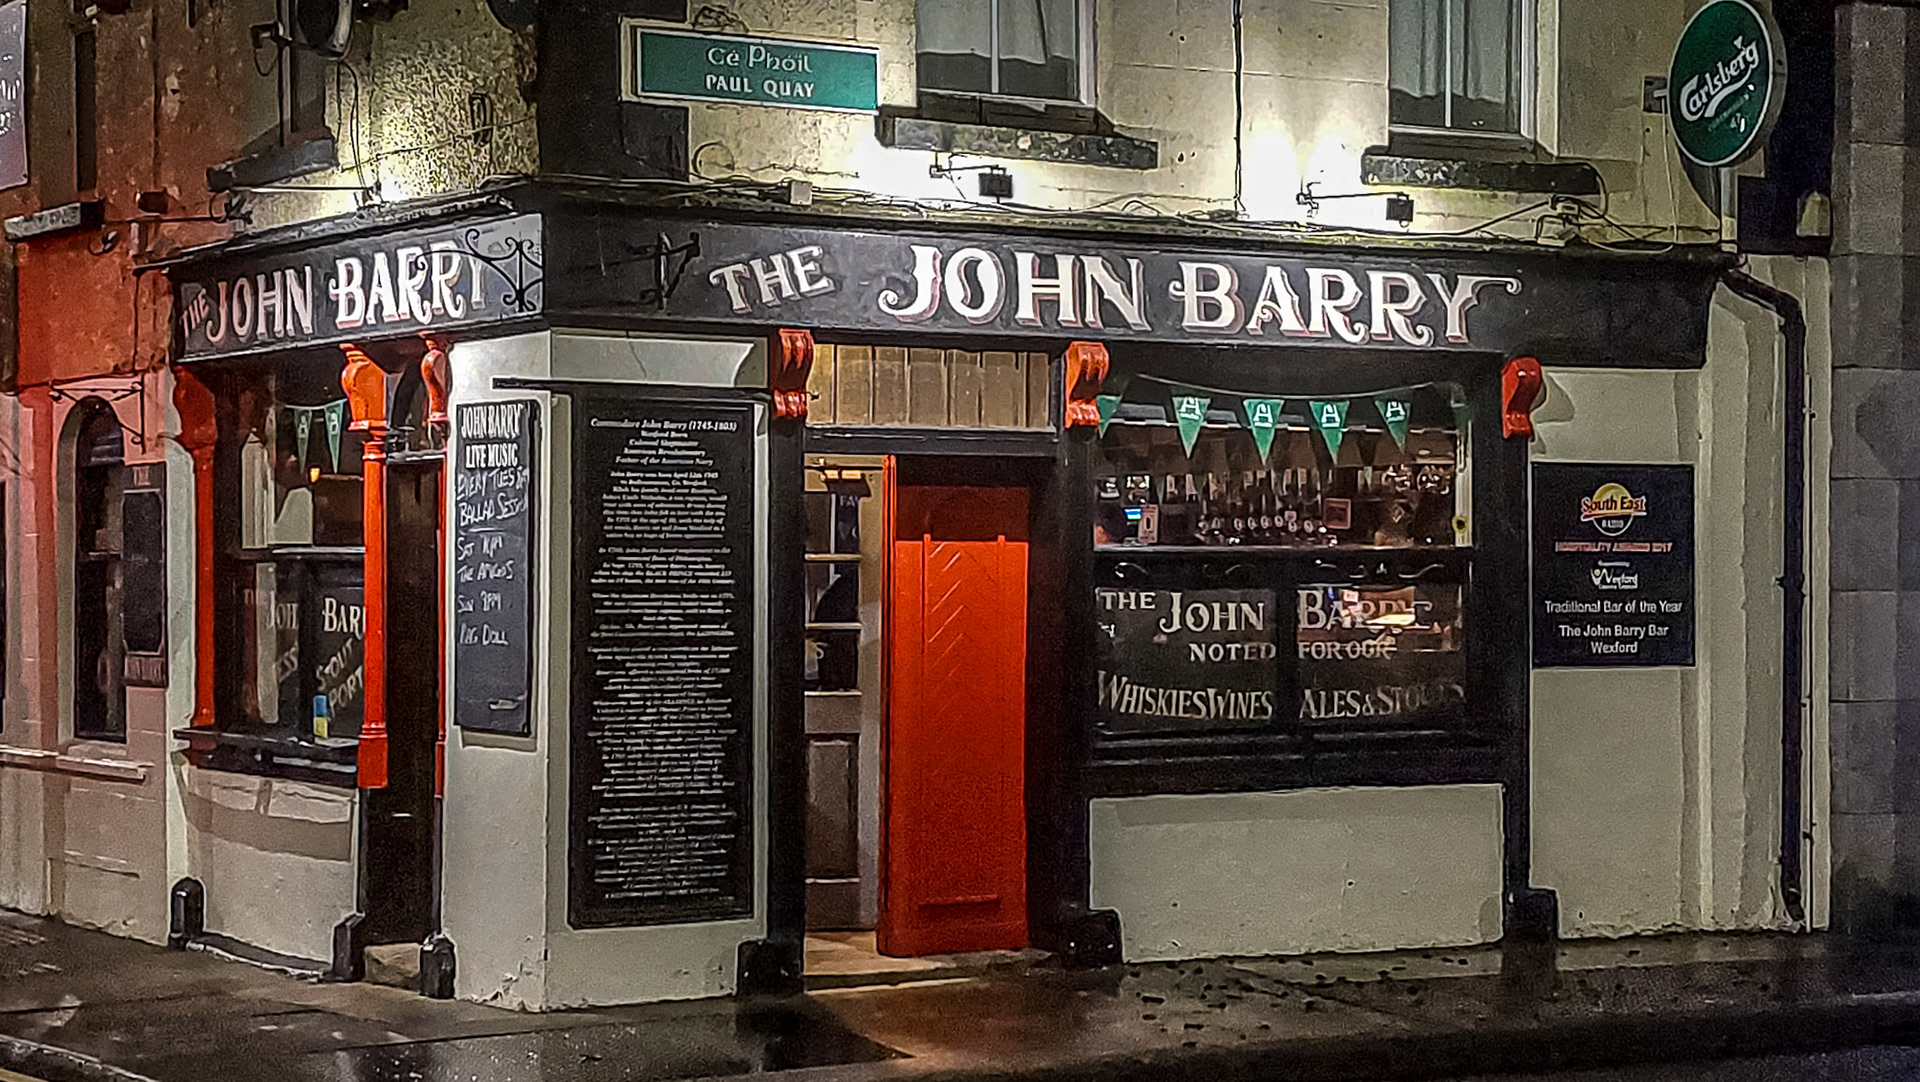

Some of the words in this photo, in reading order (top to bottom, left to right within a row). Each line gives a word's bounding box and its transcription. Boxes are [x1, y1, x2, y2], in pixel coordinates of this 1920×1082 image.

[706, 74, 753, 93] PAUL
[763, 79, 815, 98] QUAY
[1680, 38, 1759, 121] Carlsberg
[179, 288, 210, 340] THE
[206, 266, 314, 343] JOHN
[329, 240, 492, 329] BARRY
[708, 244, 835, 314] THE
[878, 245, 1152, 331] JOHN
[1169, 261, 1522, 346] BARRY
[461, 407, 487, 439] JOHN
[488, 403, 524, 439] BARRY
[466, 445, 486, 468] LIVE
[488, 443, 518, 467] MUSIC
[1581, 496, 1617, 513] South
[1620, 496, 1646, 511] East
[1101, 591, 1156, 610] THE
[1159, 592, 1264, 633] JOHN
[1545, 600, 1600, 613] Traditional
[1603, 600, 1622, 613] Bar
[1625, 600, 1637, 613] of
[1639, 600, 1657, 613] the
[1659, 600, 1682, 613] Year
[1559, 625, 1581, 637] The
[1583, 624, 1612, 637] John
[1614, 625, 1646, 639] Barry
[1648, 624, 1669, 636] Bar
[1188, 643, 1276, 662] NOTED
[1298, 641, 1343, 660] FOR
[1591, 641, 1638, 654] Wexford
[1097, 670, 1206, 719] WHISKIES
[1206, 687, 1273, 720] WINES
[1299, 688, 1360, 719] ALES
